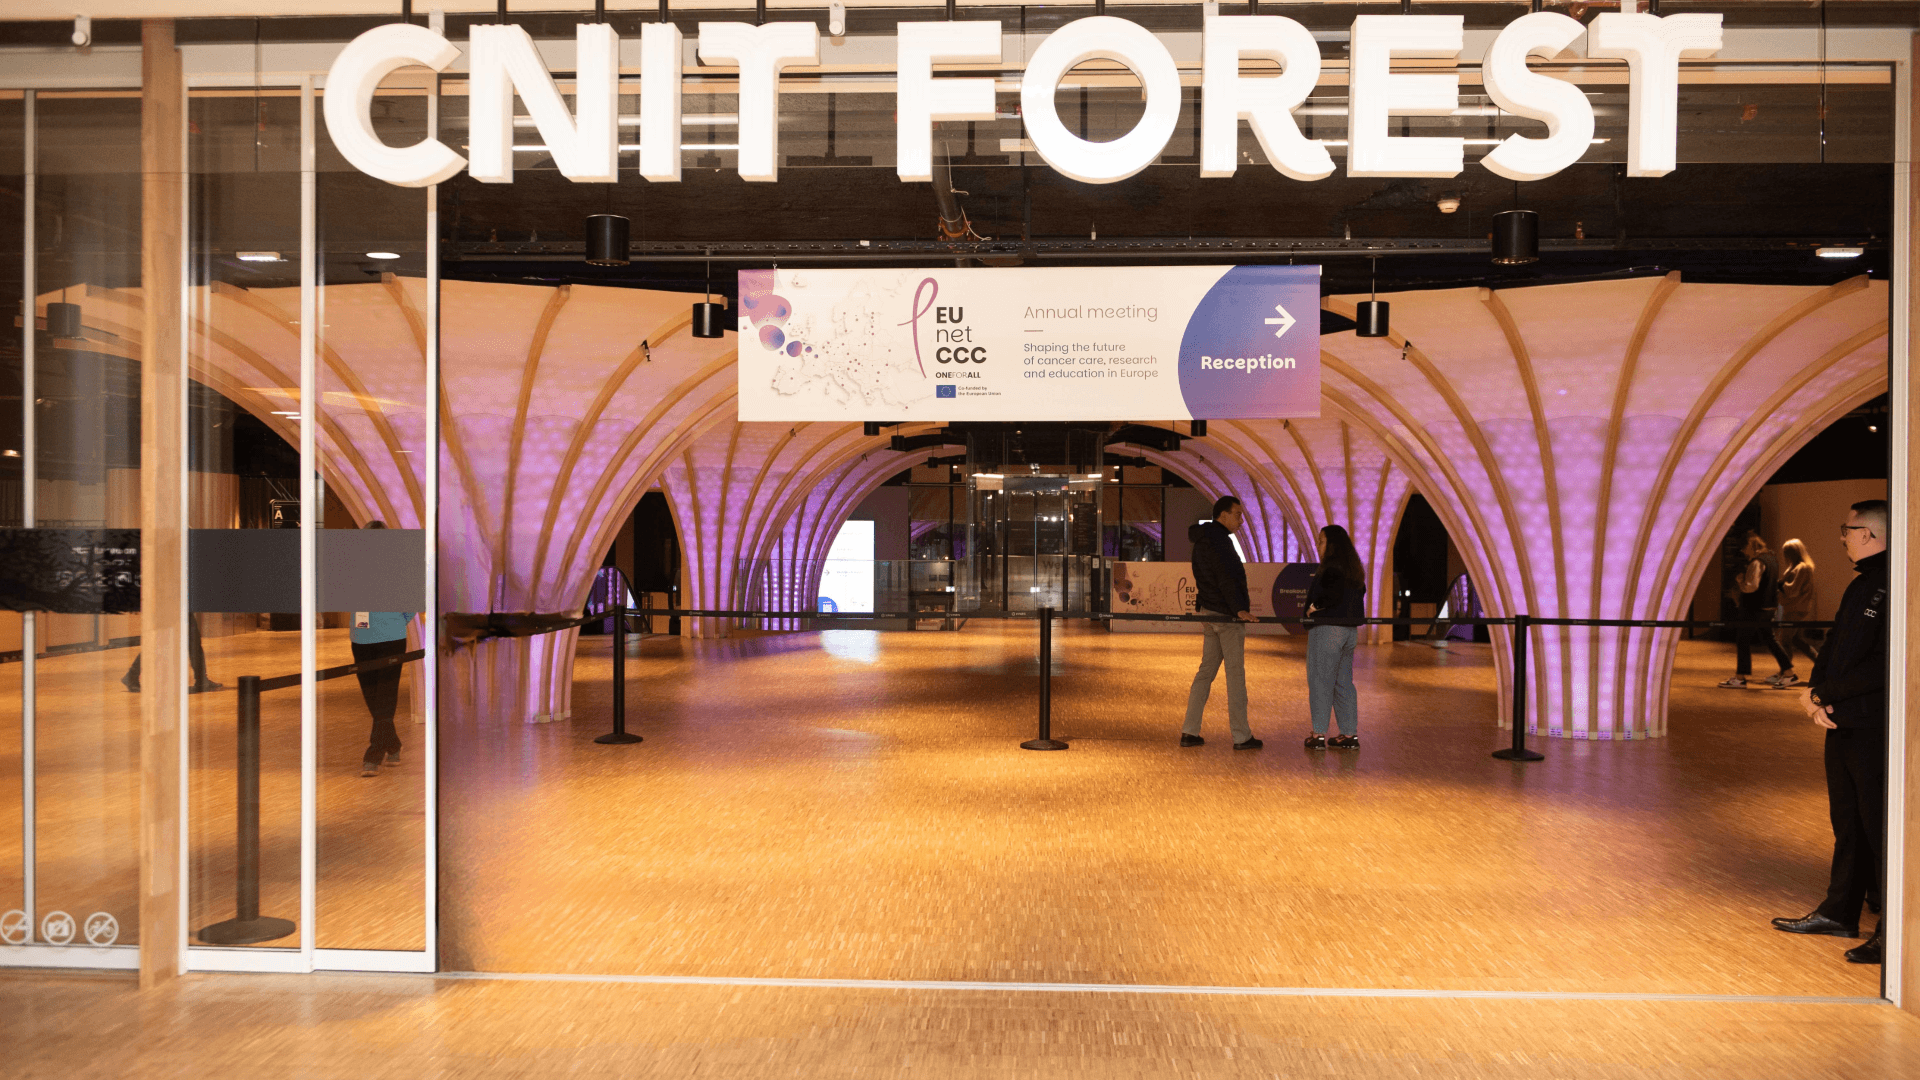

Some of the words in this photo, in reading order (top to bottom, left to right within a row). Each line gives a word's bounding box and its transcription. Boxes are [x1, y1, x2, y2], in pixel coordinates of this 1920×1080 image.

[324, 22, 820, 187] CNIT
[897, 11, 1723, 184] FOREST
[936, 306, 964, 324] EU
[1023, 305, 1083, 319] Annual
[1087, 304, 1158, 322] meeting
[936, 325, 972, 343] net
[935, 346, 987, 364] CCC
[1023, 342, 1069, 354] Shaping
[1071, 343, 1090, 352] the
[1092, 342, 1126, 352] future
[1023, 356, 1034, 365] of
[1037, 357, 1076, 365] cancer
[1078, 357, 1106, 366] care,
[1108, 355, 1157, 365] research
[1201, 354, 1296, 373] Reception
[1023, 369, 1046, 379] and
[1048, 368, 1105, 379] education
[1107, 368, 1117, 378] in
[1120, 368, 1159, 380] Europe
[274, 509, 284, 520] A
